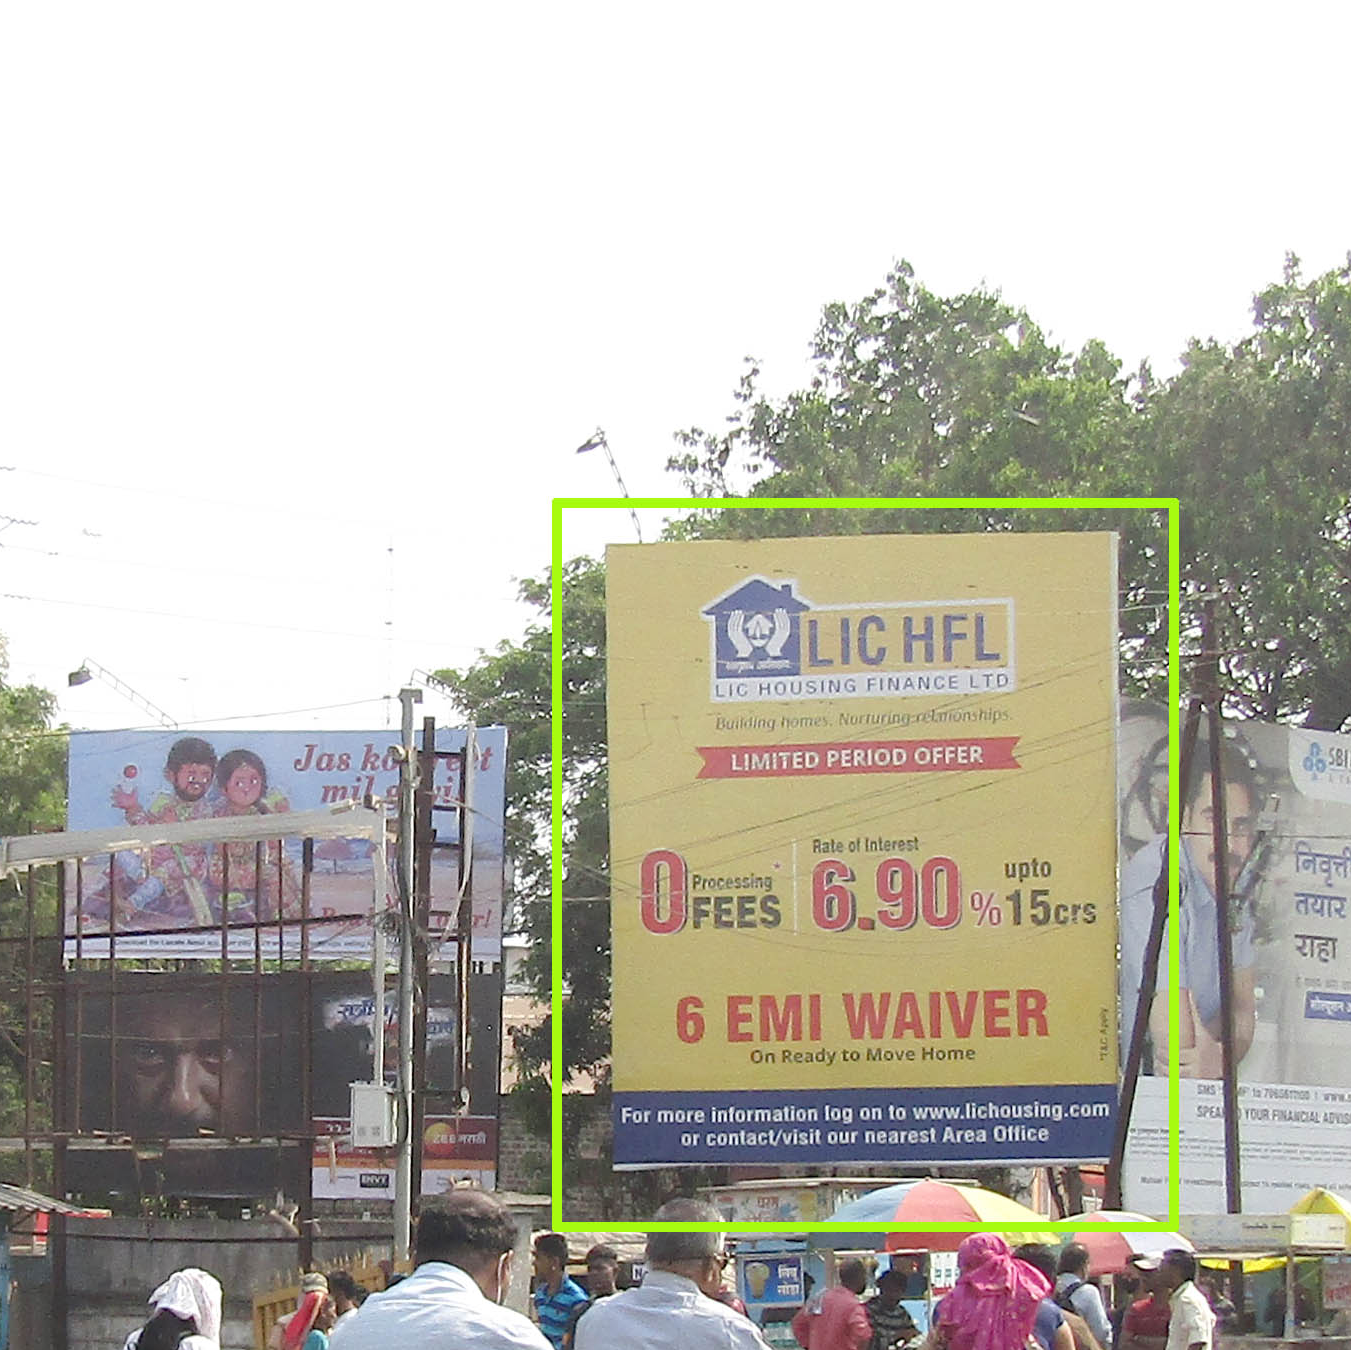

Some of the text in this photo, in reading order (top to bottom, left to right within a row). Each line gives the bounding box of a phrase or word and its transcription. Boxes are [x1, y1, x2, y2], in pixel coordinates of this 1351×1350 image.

[808, 612, 1001, 667] LIC HFL
[715, 673, 1009, 698] LIC HOUSING FINANCE LTD
[715, 715, 776, 732] Building
[838, 711, 910, 727] Nurturing
[294, 744, 352, 772] Jas
[731, 746, 984, 772] LIMITED PERIOD OFFER
[1328, 747, 1348, 769] SBI
[321, 776, 375, 804] mil
[812, 836, 919, 853] Rate of Interest
[692, 873, 772, 891] Processing
[1004, 858, 1051, 882] upto
[640, 848, 687, 936] 0
[693, 895, 782, 929] FEES
[1294, 892, 1347, 919] तयार
[1294, 934, 1338, 963] राहा
[676, 989, 1050, 1043] 6 EMI WAIVER
[750, 1046, 976, 1067] On Ready to Move Home
[1197, 1085, 1216, 1095] SMS
[621, 1101, 1110, 1124] For more information log on to www.lichousing.com
[1196, 1105, 1225, 1118] SPEA
[1245, 1108, 1269, 1121] YOUR
[1272, 1110, 1320, 1124] FINANCIAL
[681, 1125, 1050, 1146] or contact/visit our nearest Area Office
